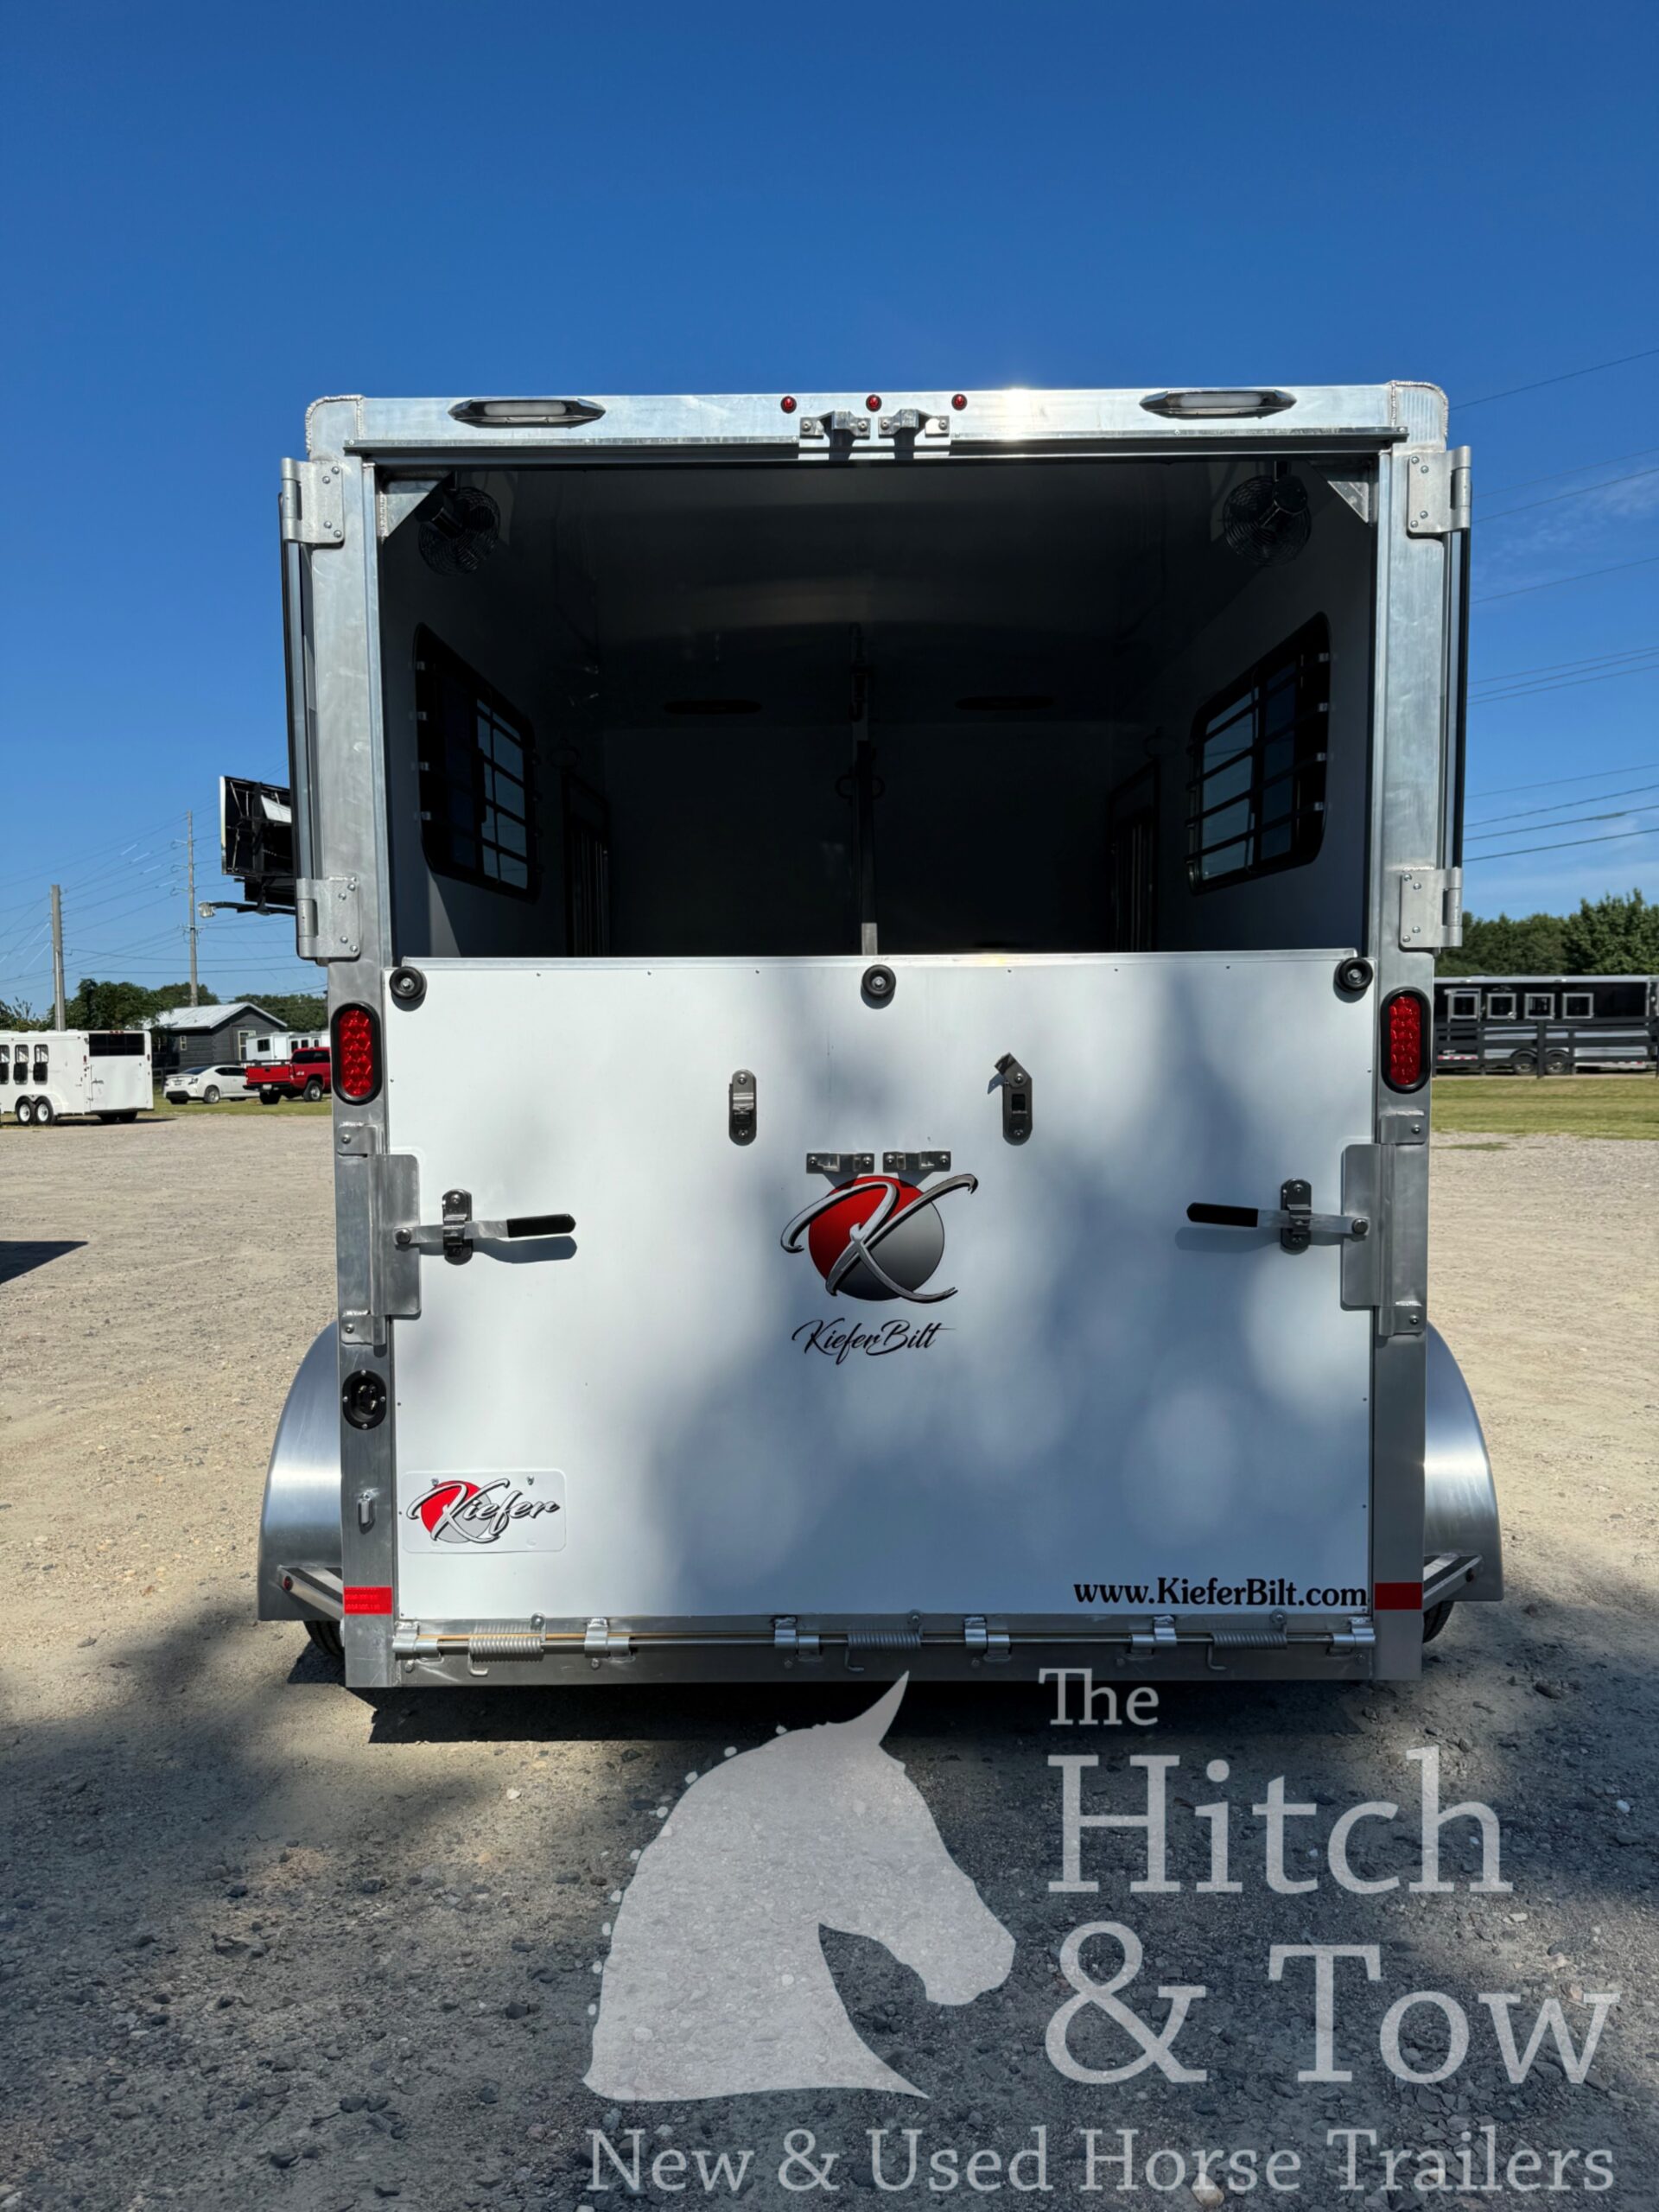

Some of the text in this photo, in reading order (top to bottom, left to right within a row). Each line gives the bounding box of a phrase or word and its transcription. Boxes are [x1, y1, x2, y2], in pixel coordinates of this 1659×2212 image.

[791, 1317, 956, 1365] KieferBilt
[406, 1478, 560, 1544] Kiefer
[1074, 1577, 1367, 1606] www.KieferBilt.com
